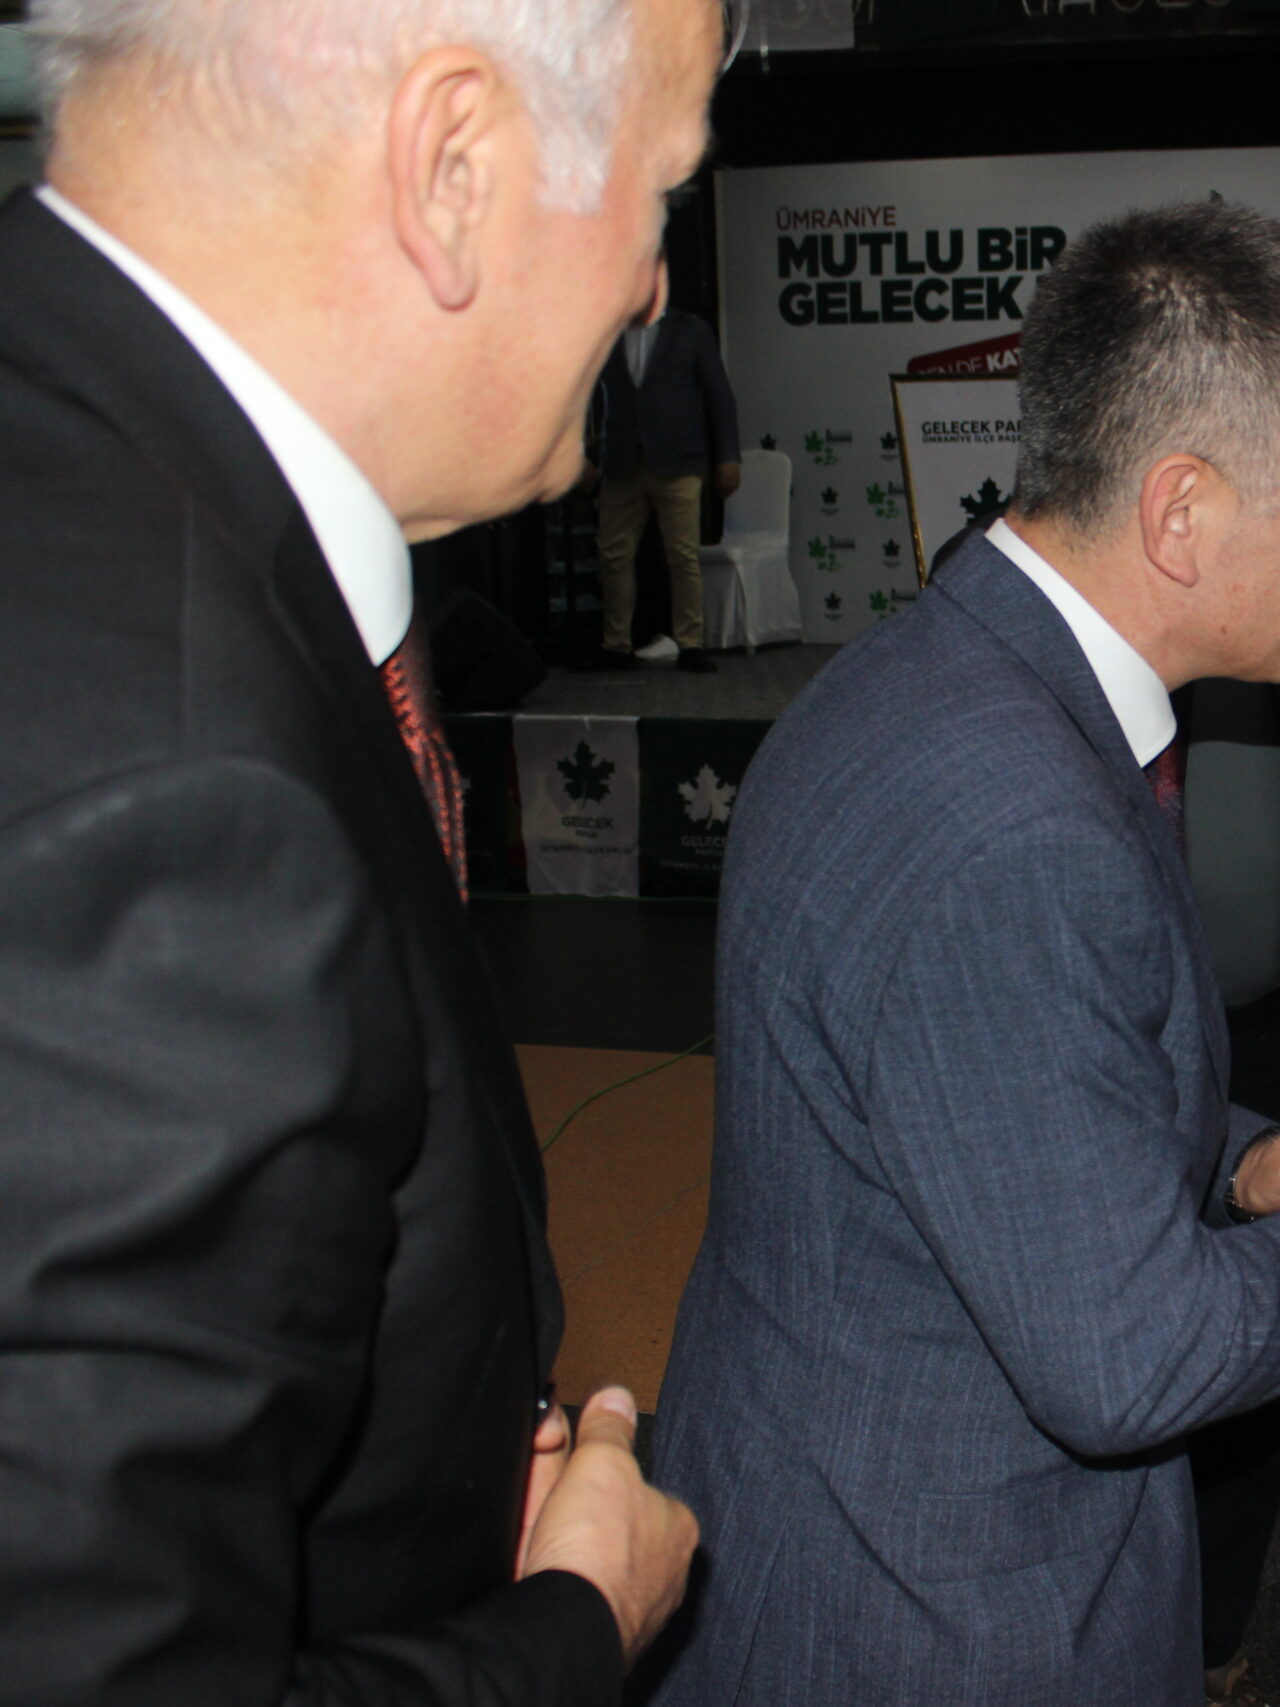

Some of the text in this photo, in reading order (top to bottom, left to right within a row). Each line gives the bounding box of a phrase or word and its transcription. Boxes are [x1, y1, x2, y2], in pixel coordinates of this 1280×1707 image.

[777, 228, 964, 279] MUTLU
[778, 275, 1024, 327] GELECEK
[922, 421, 991, 435] GELECEK
